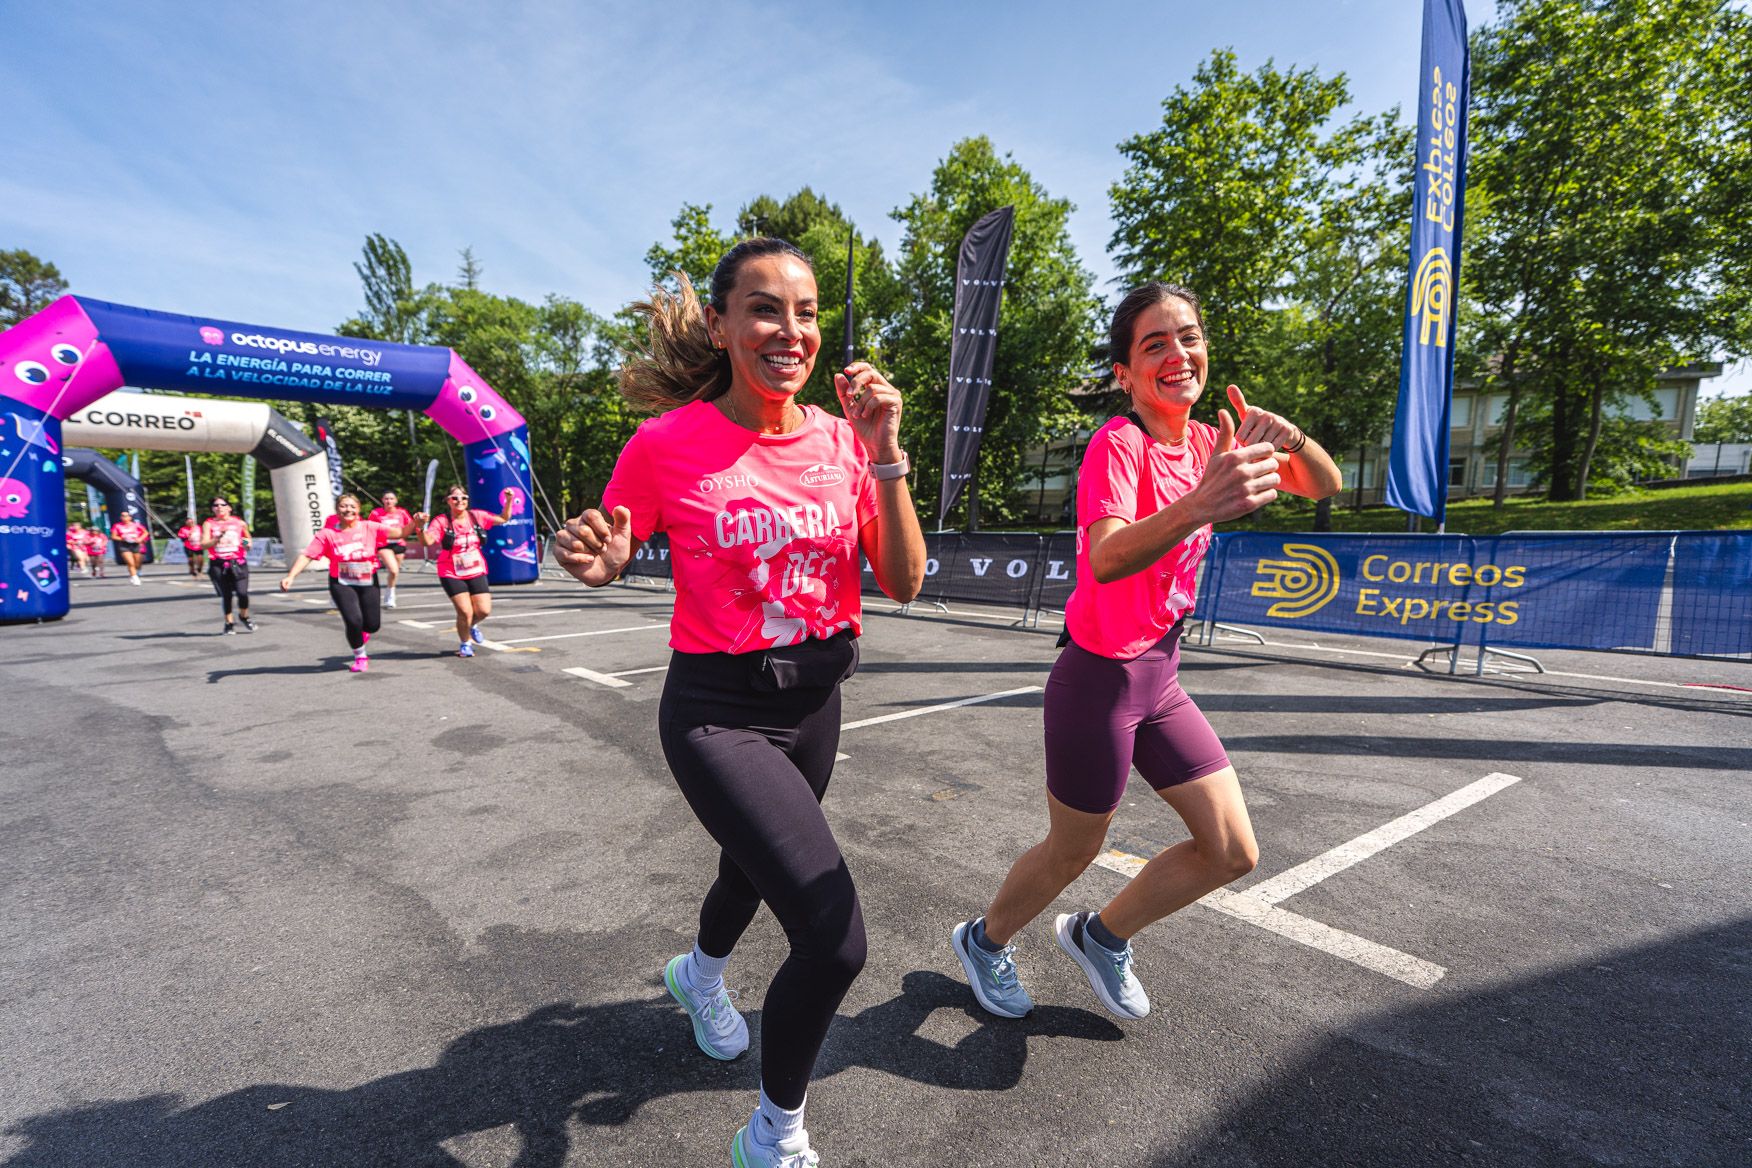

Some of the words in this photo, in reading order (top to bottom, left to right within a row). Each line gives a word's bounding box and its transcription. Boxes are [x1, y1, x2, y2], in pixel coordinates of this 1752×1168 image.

[189, 350, 212, 364] LA
[216, 354, 288, 372] ENERGÍA
[291, 363, 333, 378] PARA
[335, 367, 392, 383] CORRER
[186, 366, 200, 377] A
[203, 367, 226, 380] LA
[231, 370, 321, 389] VELOCIDAD
[322, 379, 343, 391] DE
[345, 382, 363, 393] LA
[366, 384, 394, 396] LUZ
[87, 411, 195, 430] CORREO
[305, 474, 316, 490] EL
[700, 474, 760, 493] OYSHO
[308, 492, 322, 535] CORRE
[635, 548, 670, 561] OLV
[970, 558, 1070, 580] VOL
[1362, 554, 1527, 588] Correos
[1355, 588, 1521, 625] Express
